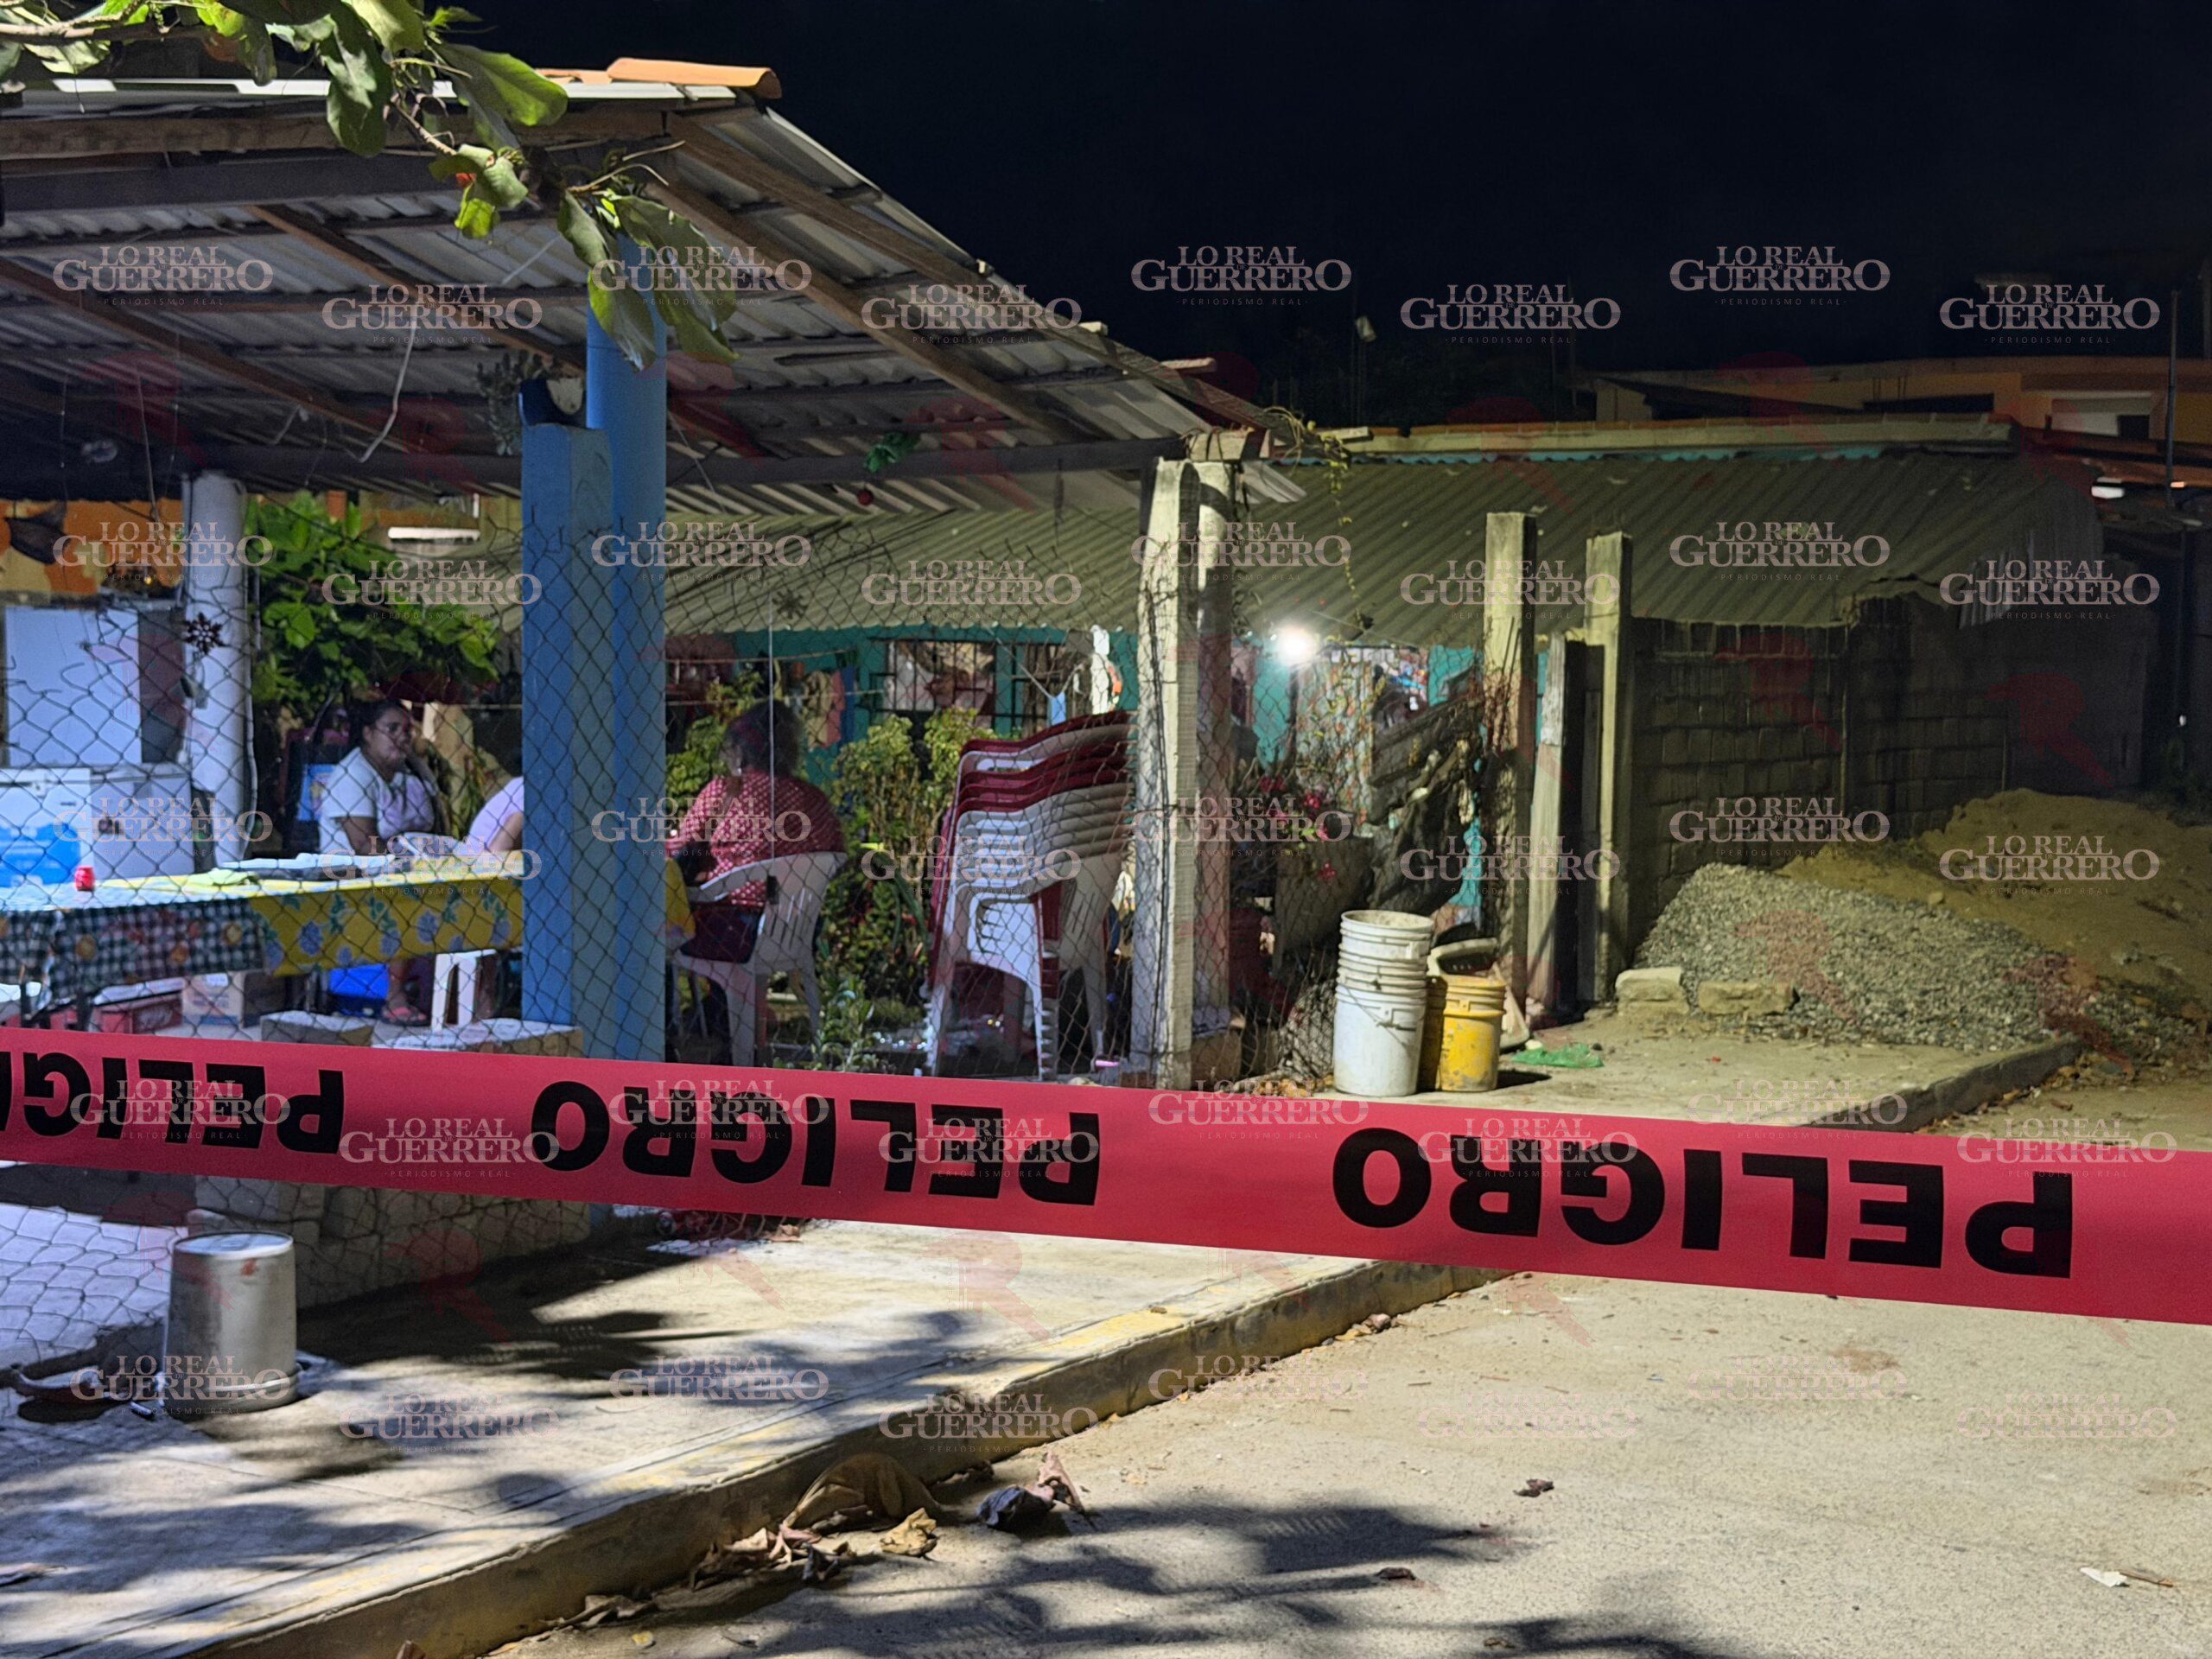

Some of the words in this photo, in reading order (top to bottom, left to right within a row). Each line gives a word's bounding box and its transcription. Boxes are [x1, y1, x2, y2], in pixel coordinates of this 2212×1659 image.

[0, 1051, 344, 1154] PELIG
[532, 1080, 1099, 1206] PELIGRO
[1332, 1128, 2074, 1279] PELIGRO
